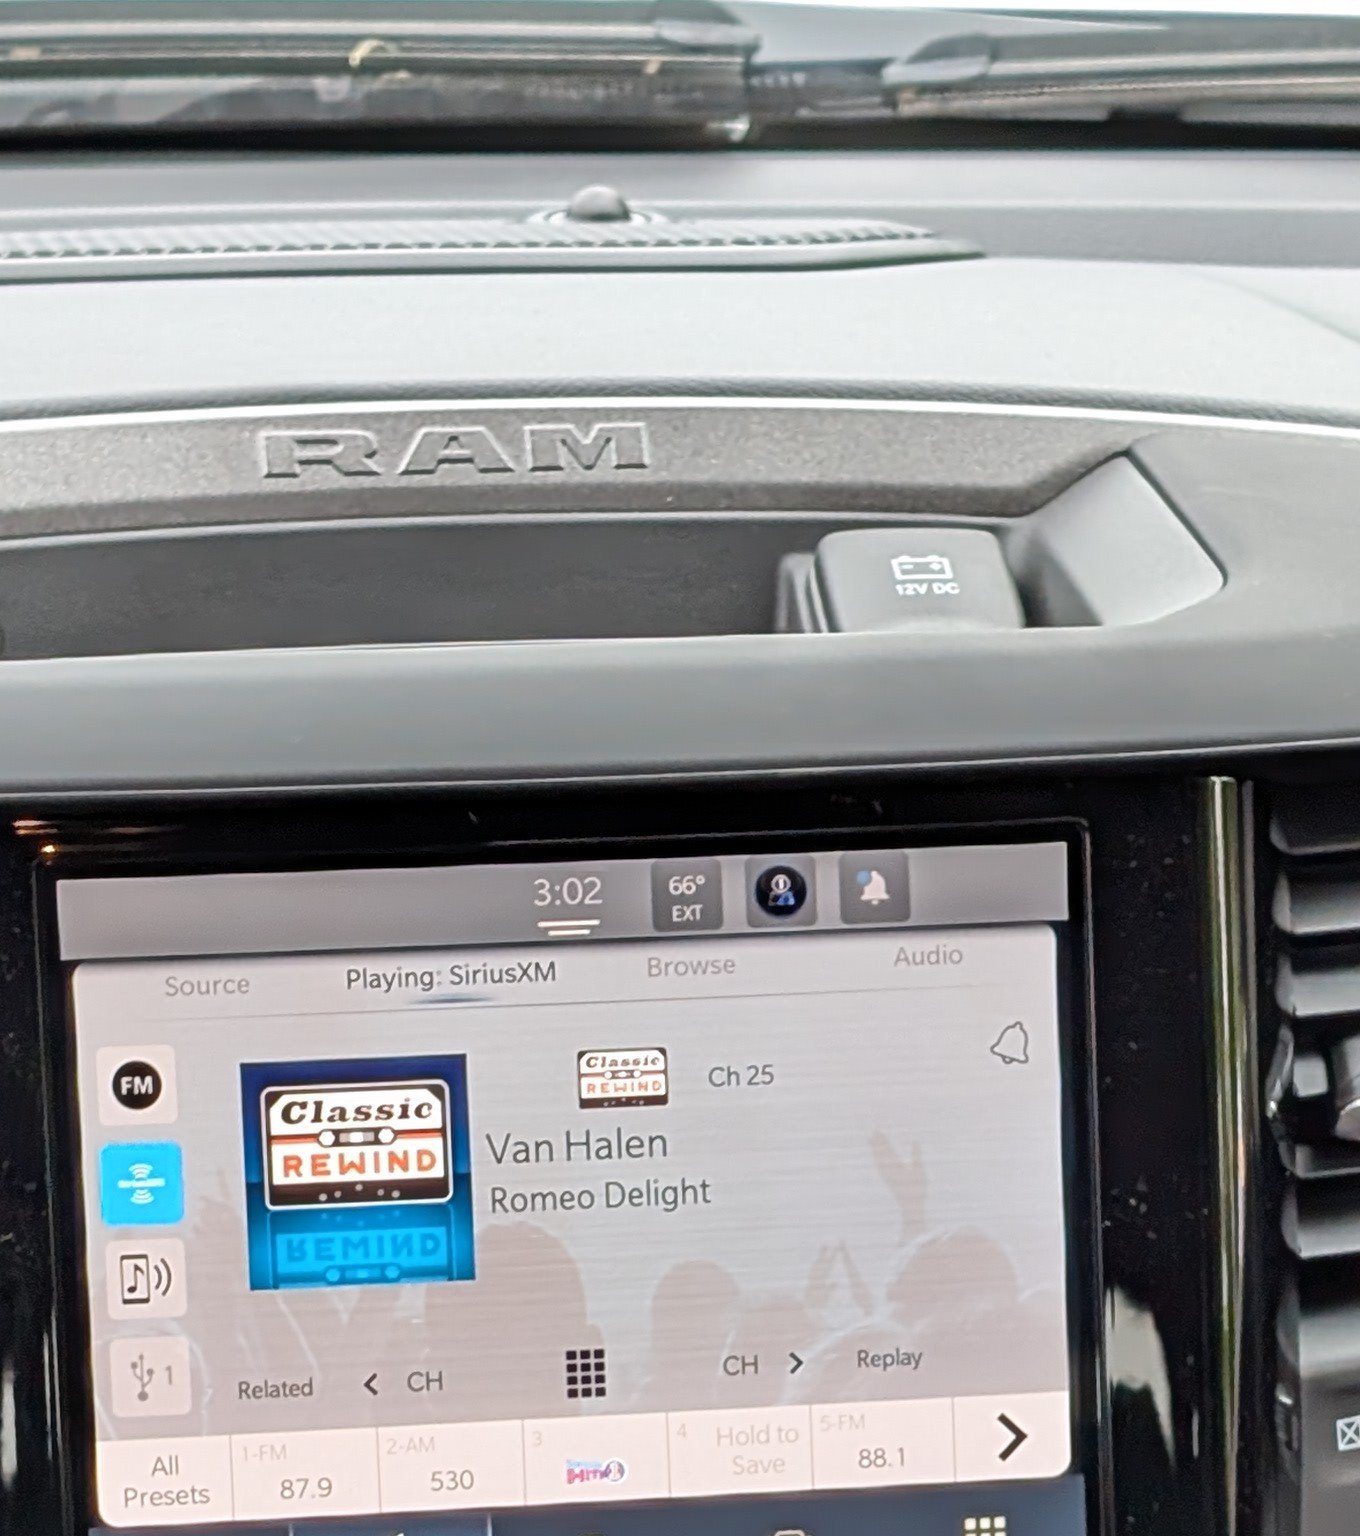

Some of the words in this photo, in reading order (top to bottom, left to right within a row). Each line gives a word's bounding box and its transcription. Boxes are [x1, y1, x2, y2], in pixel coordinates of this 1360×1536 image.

[260, 422, 649, 477] RAM
[896, 580, 927, 596] 12V
[932, 580, 961, 596] DC
[533, 877, 603, 907] 3:02
[672, 904, 703, 923] EXT
[647, 956, 737, 978] Browse
[893, 944, 964, 967] Audio
[164, 975, 251, 998] Source
[345, 966, 443, 993] Playing:
[448, 961, 557, 987] SiriusXM
[585, 1054, 661, 1068] Classic
[120, 1076, 154, 1097] FM
[586, 1080, 662, 1094] REWIND
[708, 1065, 741, 1088] Ch
[746, 1064, 775, 1086] 25
[280, 1097, 434, 1126] Classic
[486, 1130, 554, 1164] Van
[565, 1127, 668, 1161] Halen
[282, 1148, 438, 1178] REWIND
[491, 1186, 595, 1214] Romeo
[605, 1178, 712, 1214] Delight
[722, 1355, 759, 1376] CH
[856, 1348, 923, 1372] Replay
[238, 1376, 314, 1400] Related
[407, 1371, 444, 1393] CH
[820, 1413, 866, 1432] 5-FM
[386, 1436, 436, 1455] 2-AM
[716, 1425, 771, 1448] Hold
[776, 1426, 800, 1444] to
[151, 1455, 180, 1476] All
[732, 1454, 786, 1475] Save
[858, 1446, 906, 1469] 88.1
[280, 1476, 333, 1500] 87.9
[430, 1470, 475, 1492] 530
[123, 1484, 210, 1509] Presets
